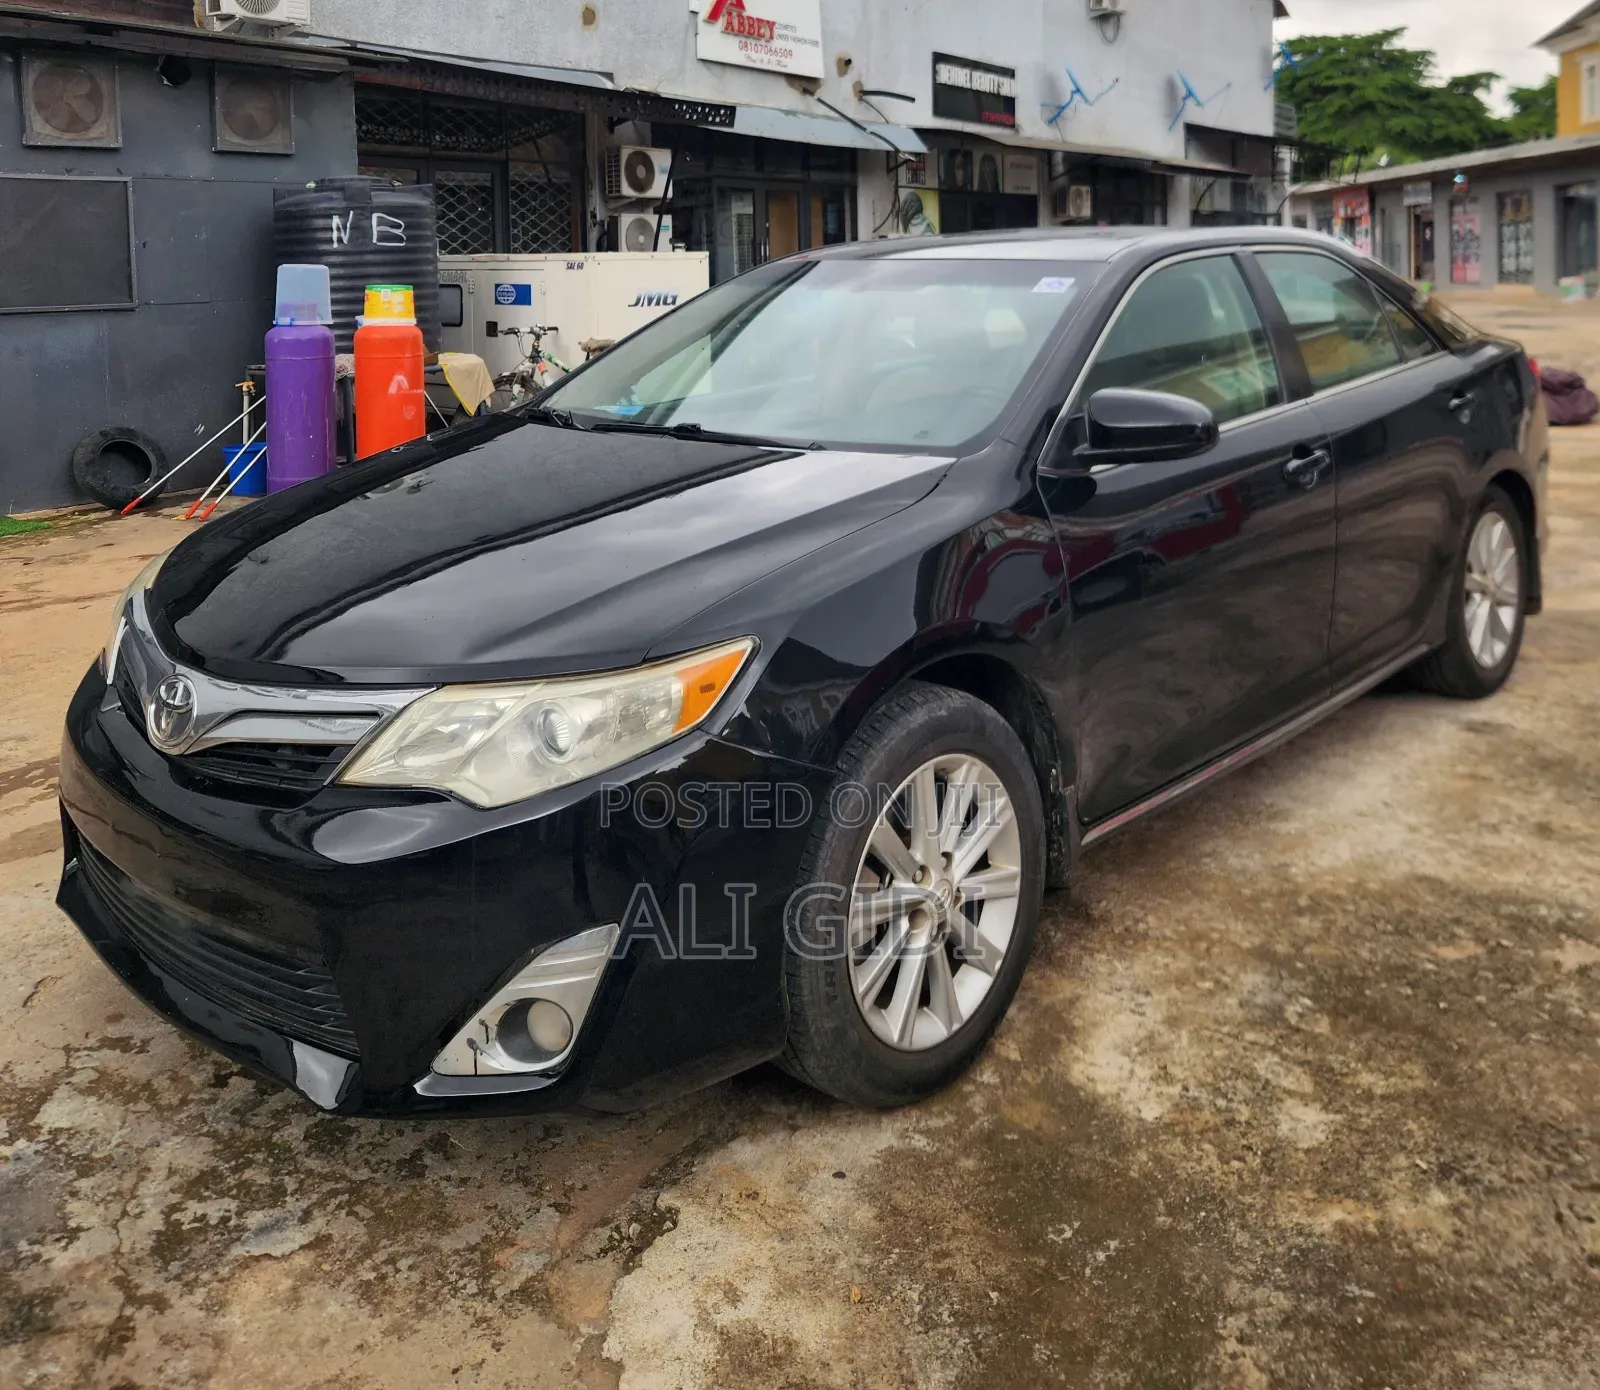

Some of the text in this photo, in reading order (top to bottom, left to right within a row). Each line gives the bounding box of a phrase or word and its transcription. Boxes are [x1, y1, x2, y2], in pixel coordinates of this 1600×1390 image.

[722, 11, 776, 41] ABBEY
[738, 40, 793, 59] 08107066509
[566, 262, 576, 270] SAE
[628, 291, 679, 307] JMG
